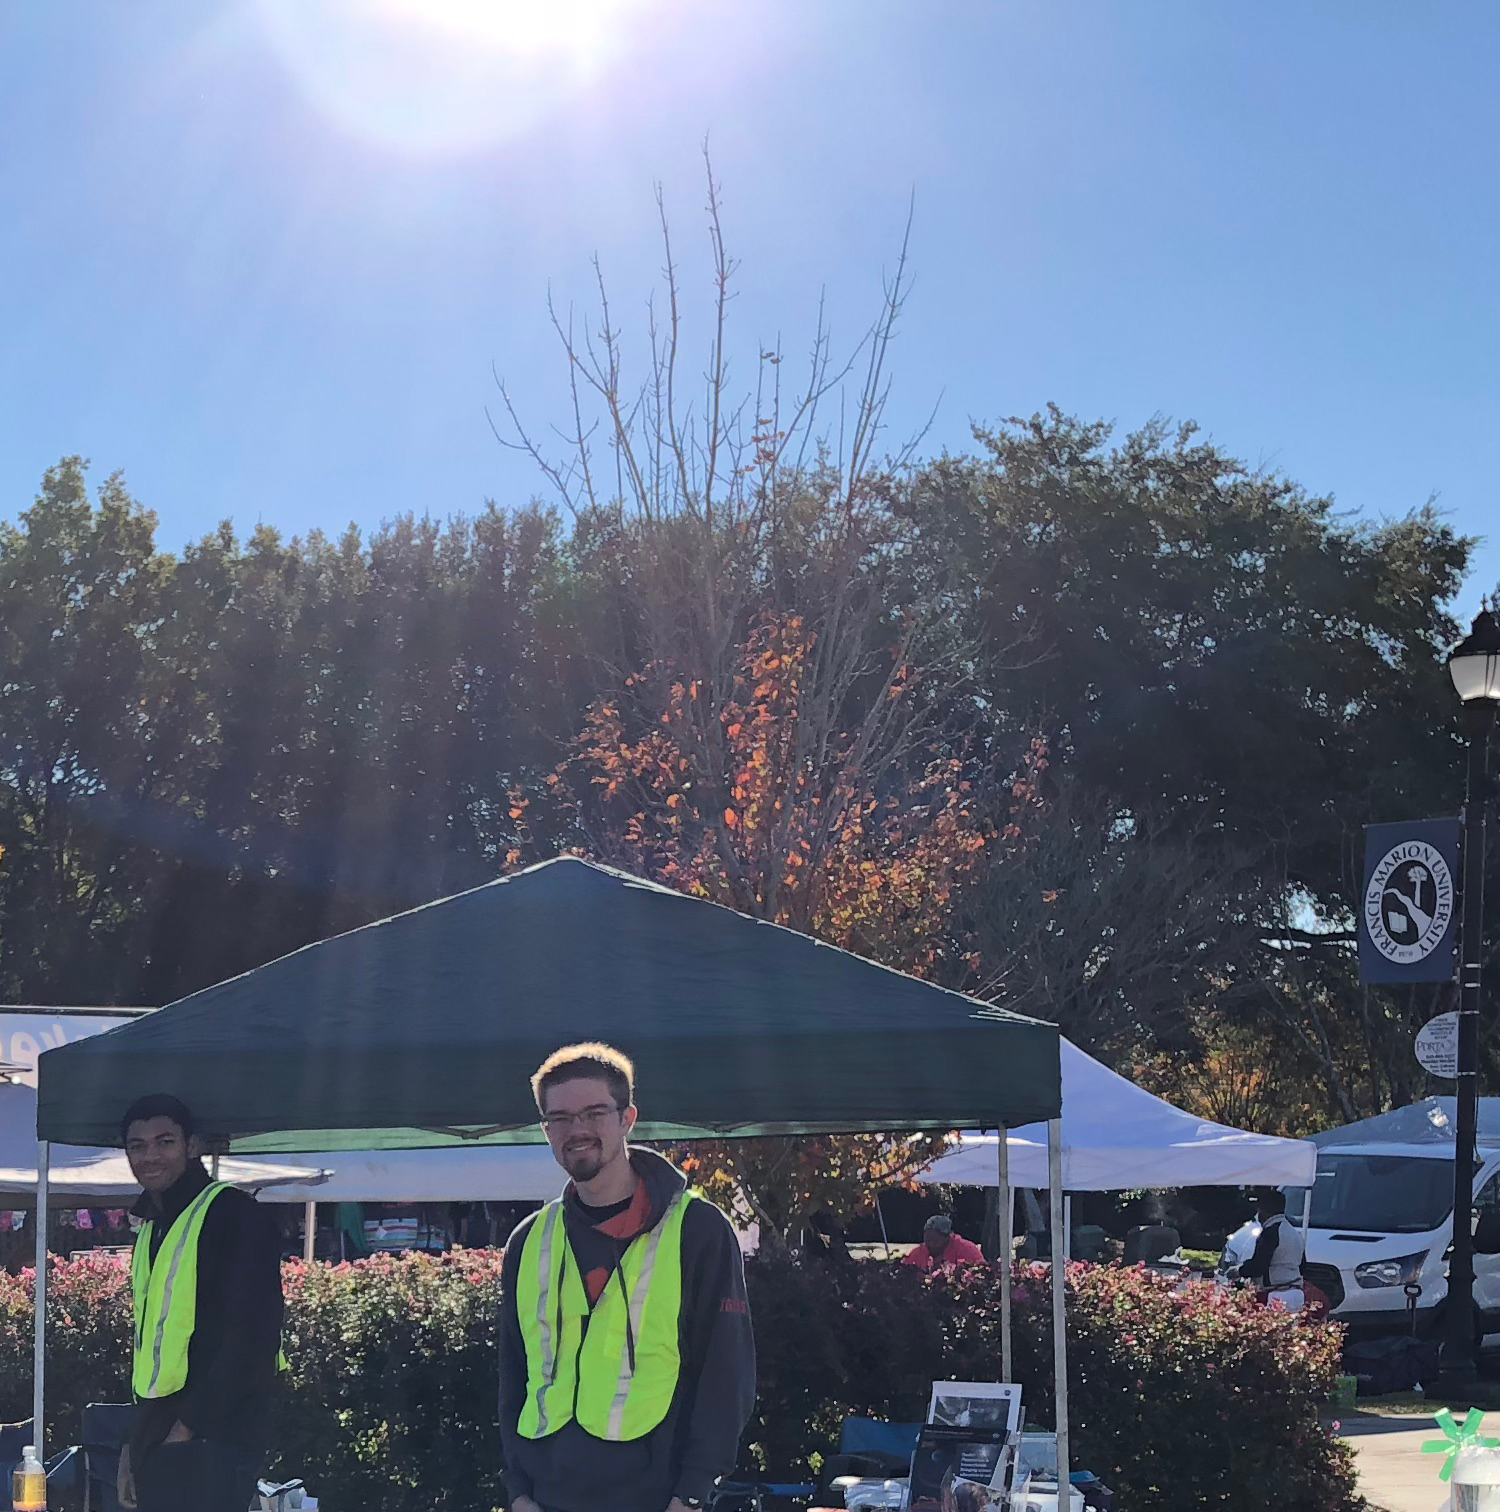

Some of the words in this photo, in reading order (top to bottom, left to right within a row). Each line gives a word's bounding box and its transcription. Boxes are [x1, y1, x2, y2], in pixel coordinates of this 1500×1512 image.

[1374, 844, 1433, 886] MARION
[1368, 891, 1397, 955] FRANCIS
[1418, 860, 1450, 956] UNIVERSITY
